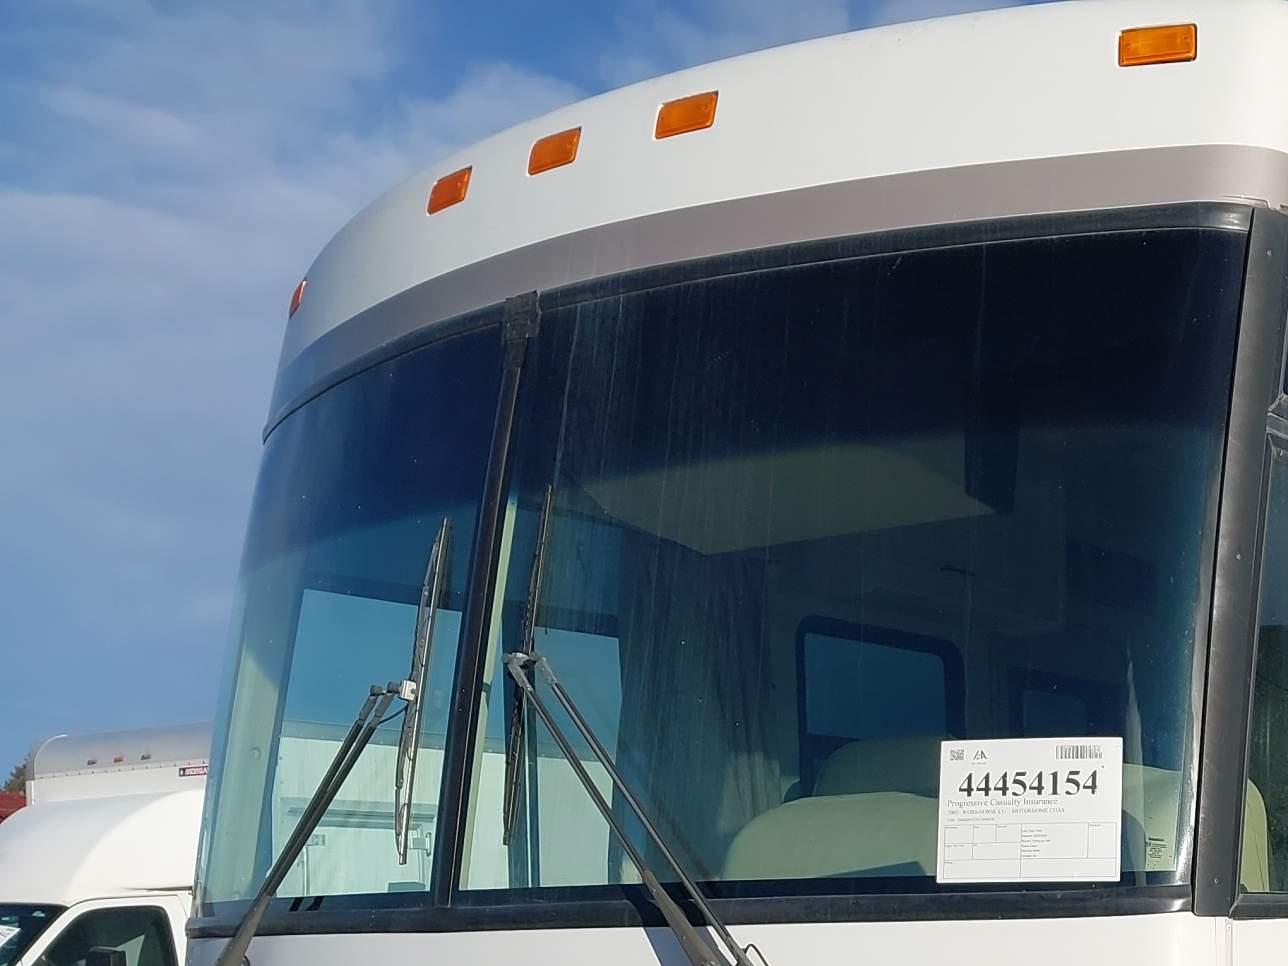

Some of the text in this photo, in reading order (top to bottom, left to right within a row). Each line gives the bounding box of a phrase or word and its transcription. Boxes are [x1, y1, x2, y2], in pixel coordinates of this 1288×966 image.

[958, 769, 1098, 798] 44454154
[947, 797, 1059, 809] Progressive Casualty Insurance
